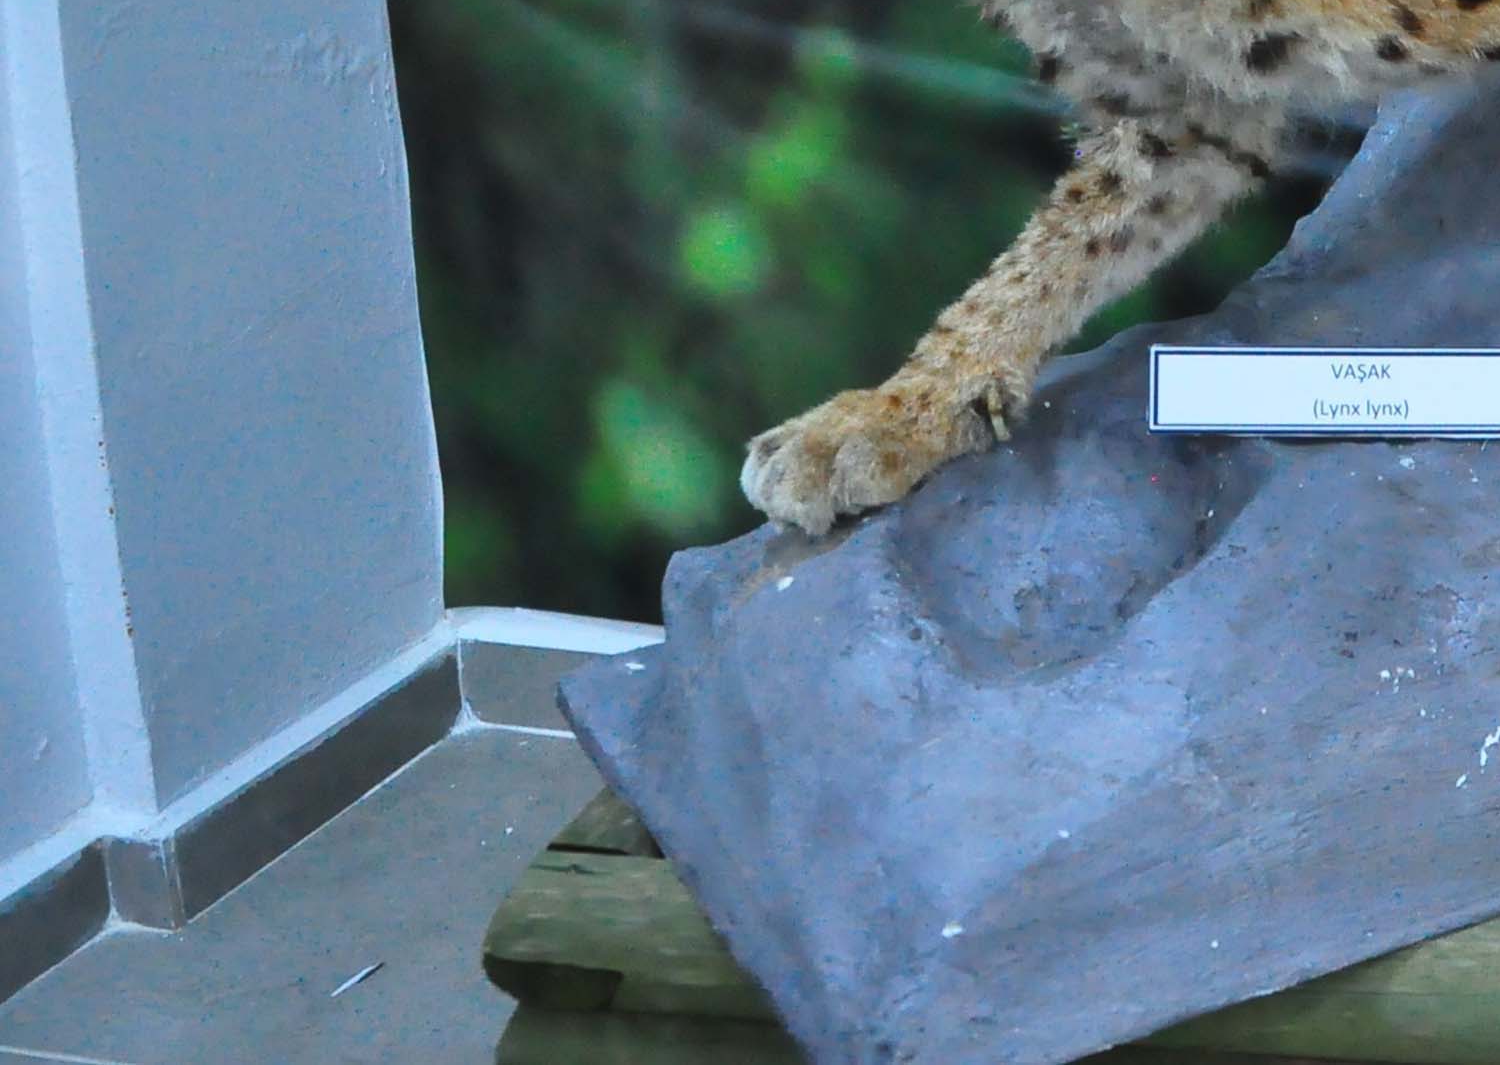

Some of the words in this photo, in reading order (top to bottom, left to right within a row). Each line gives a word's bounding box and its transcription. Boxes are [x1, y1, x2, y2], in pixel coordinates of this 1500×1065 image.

[1330, 363, 1391, 383] VAŞAK
[1313, 399, 1361, 420] (Lynx
[1366, 399, 1409, 420] lynx)
